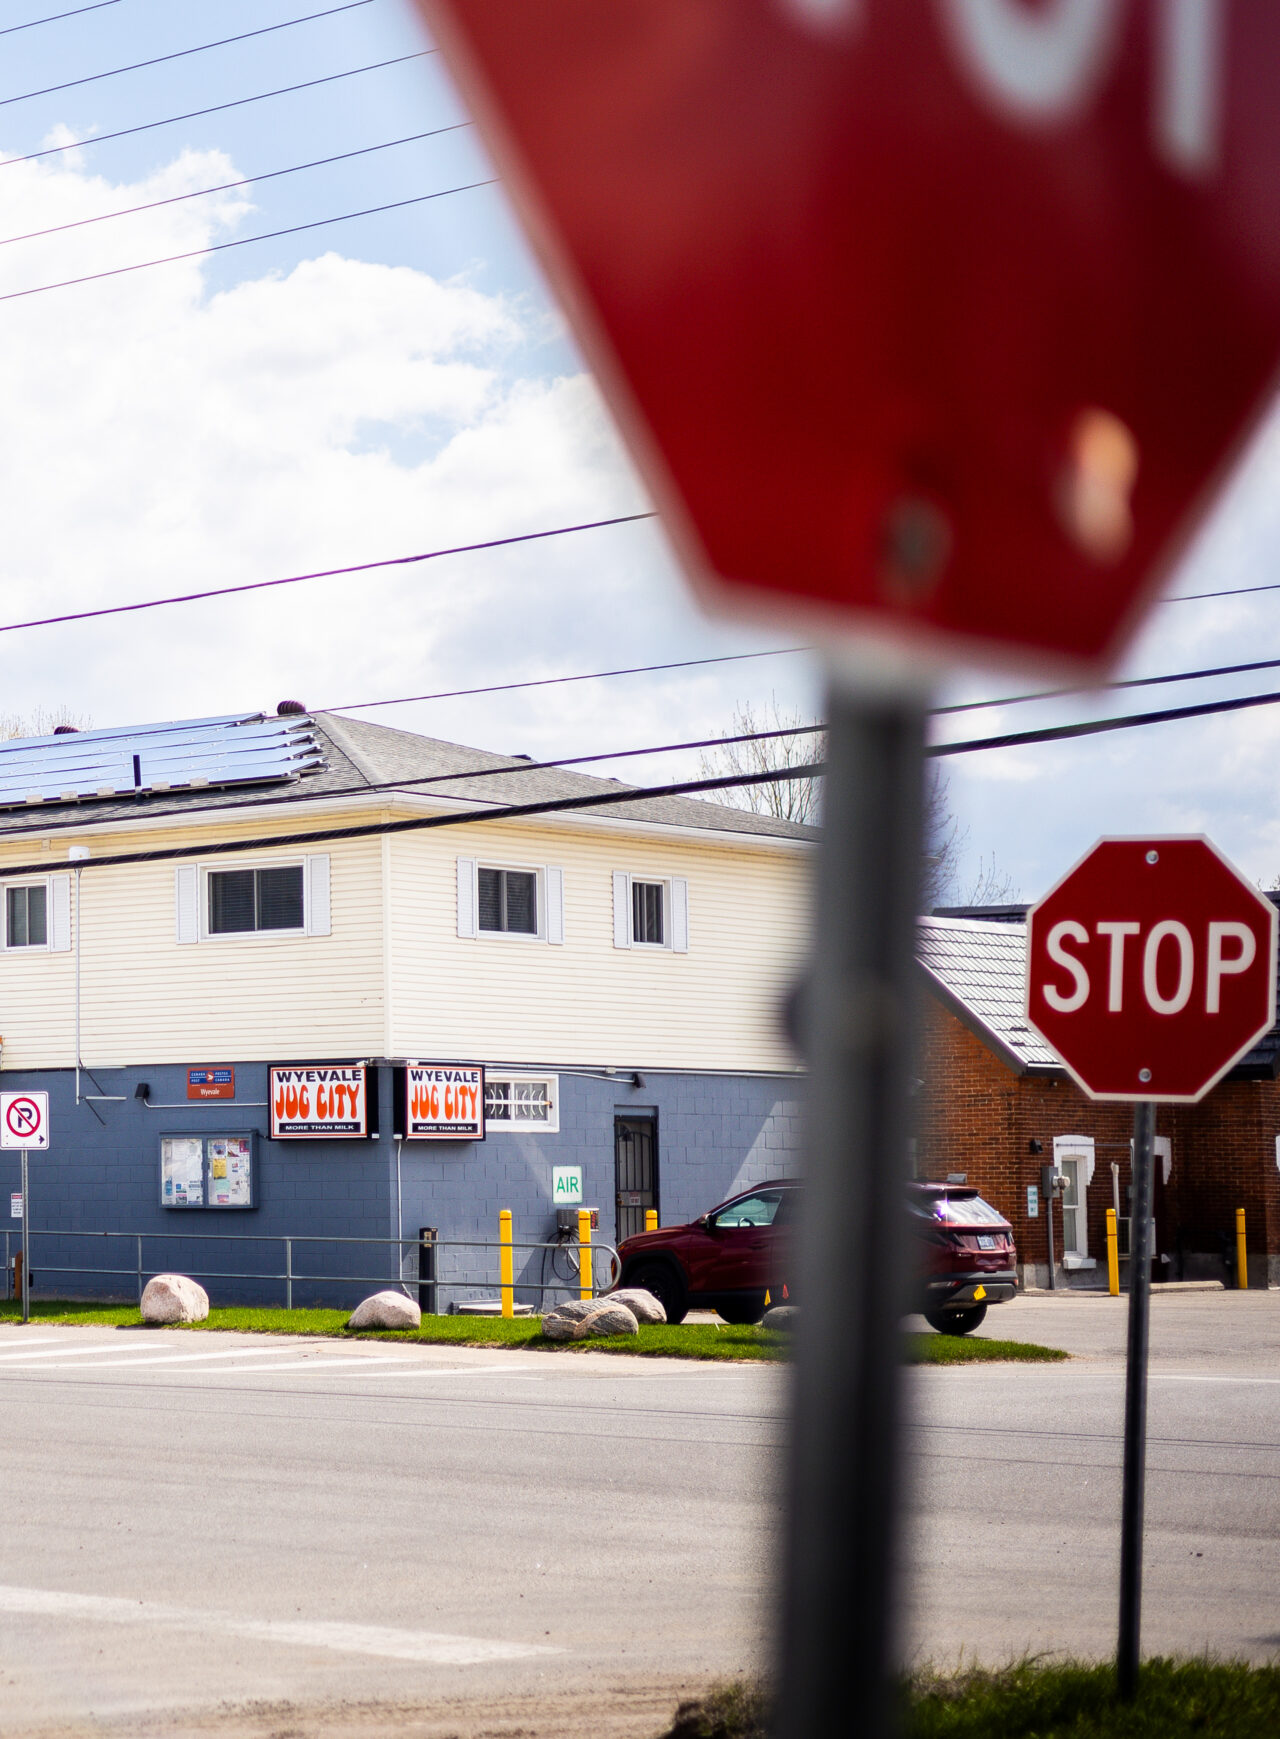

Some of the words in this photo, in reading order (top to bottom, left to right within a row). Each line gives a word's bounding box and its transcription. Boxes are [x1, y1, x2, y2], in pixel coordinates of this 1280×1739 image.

[1042, 919, 1257, 1015] STOP
[276, 1069, 362, 1083] WYEVALE
[410, 1069, 479, 1083] WYEVALE
[200, 1088, 220, 1096] Wyevale
[275, 1084, 311, 1120] JUG
[316, 1083, 360, 1120] CITY
[411, 1084, 439, 1120] JUG
[444, 1084, 478, 1120] CITY
[556, 1176, 579, 1193] AIR
